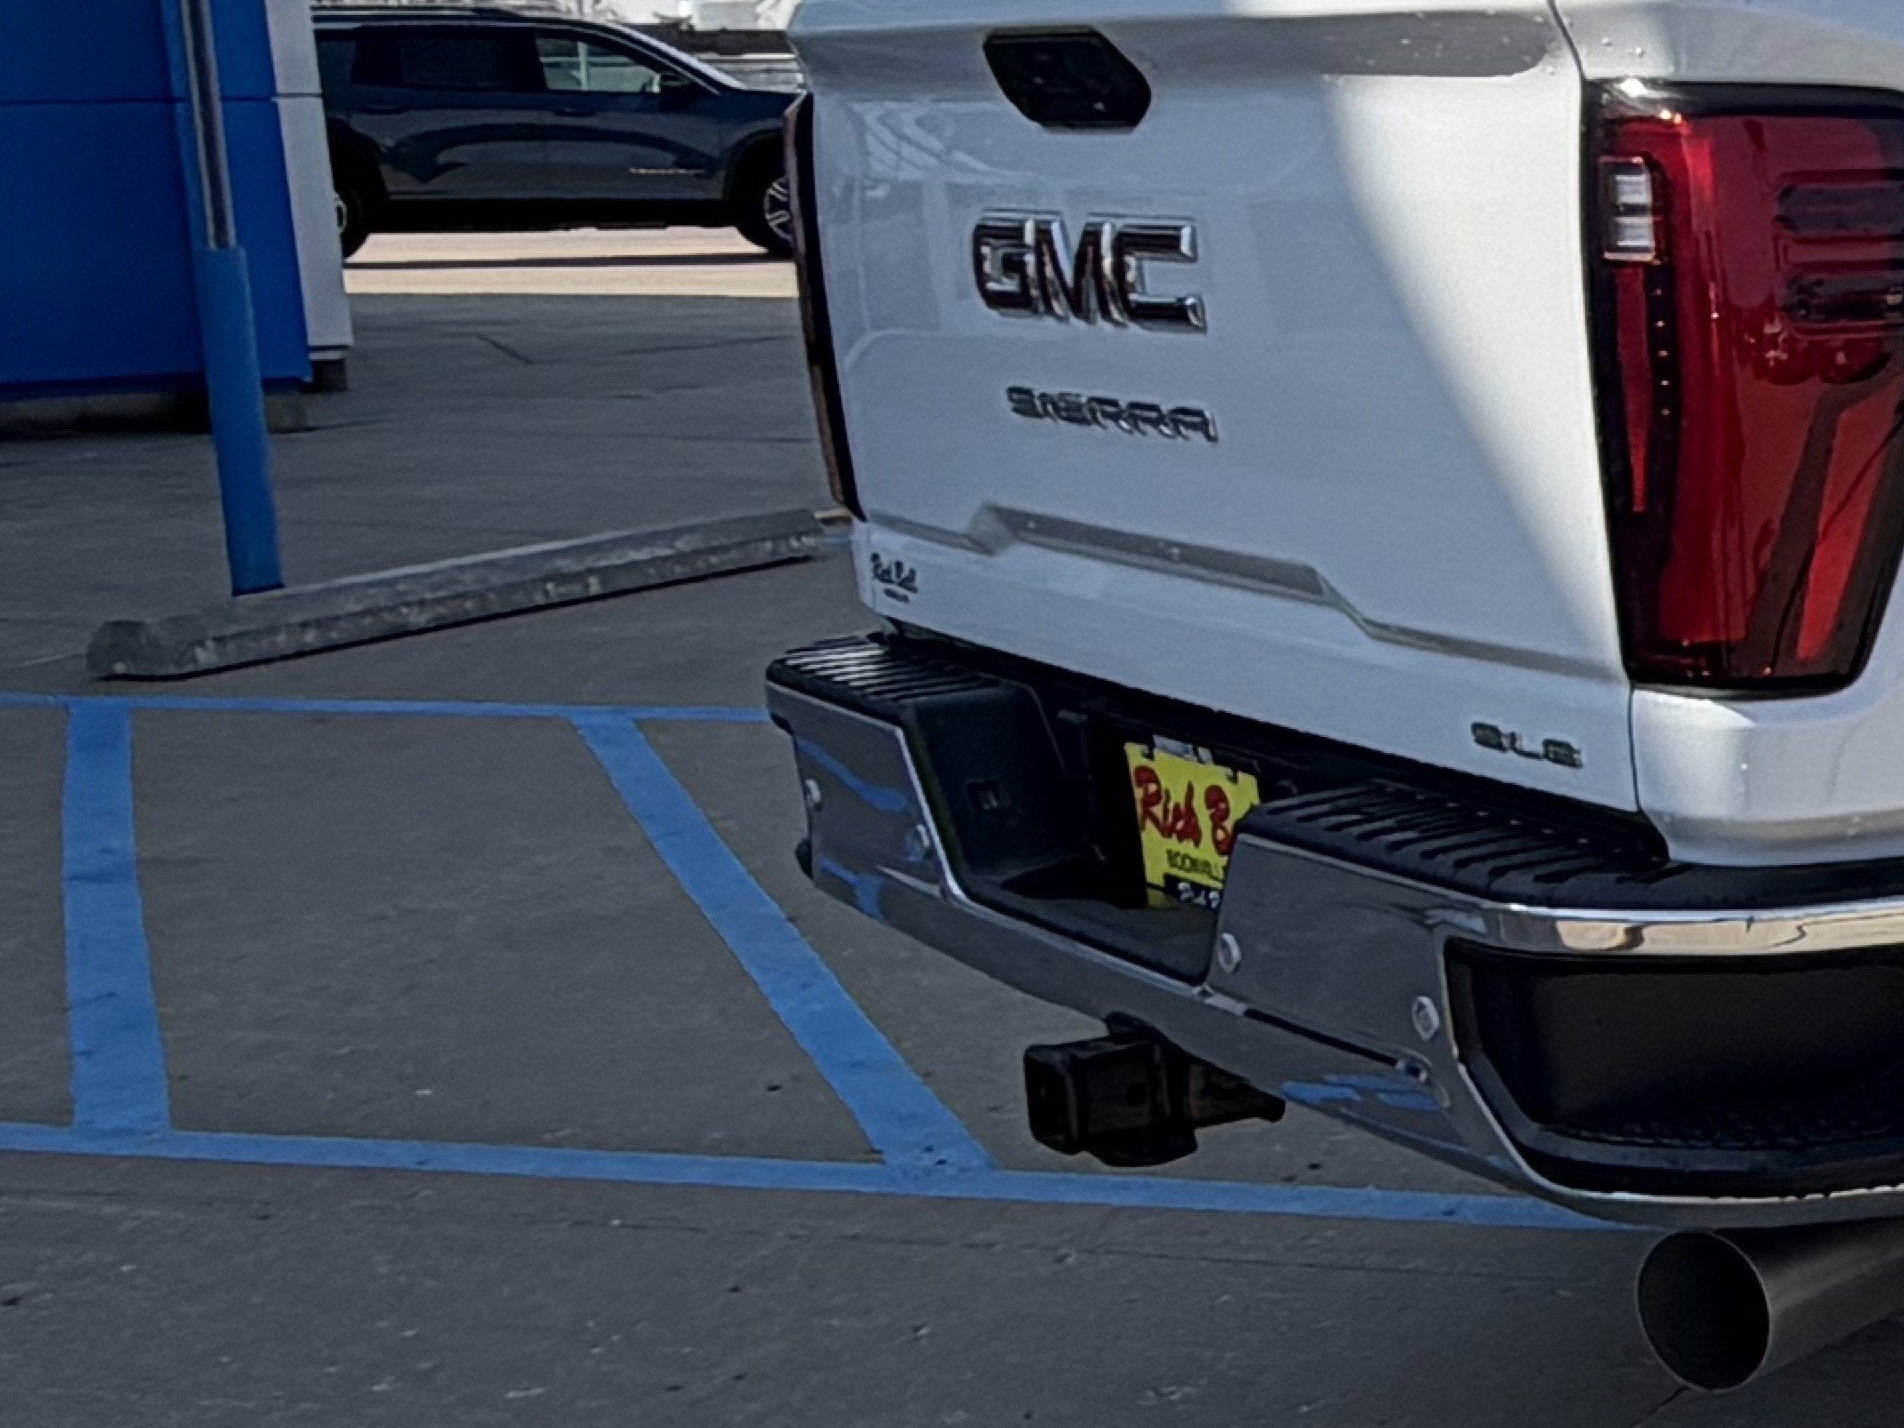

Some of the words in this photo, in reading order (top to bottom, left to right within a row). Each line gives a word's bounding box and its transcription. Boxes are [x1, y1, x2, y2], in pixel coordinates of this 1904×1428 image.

[972, 208, 1208, 335] GMC
[1006, 385, 1219, 443] SIERRA
[1470, 720, 1583, 770] SLE
[1134, 765, 1202, 847] Rick
